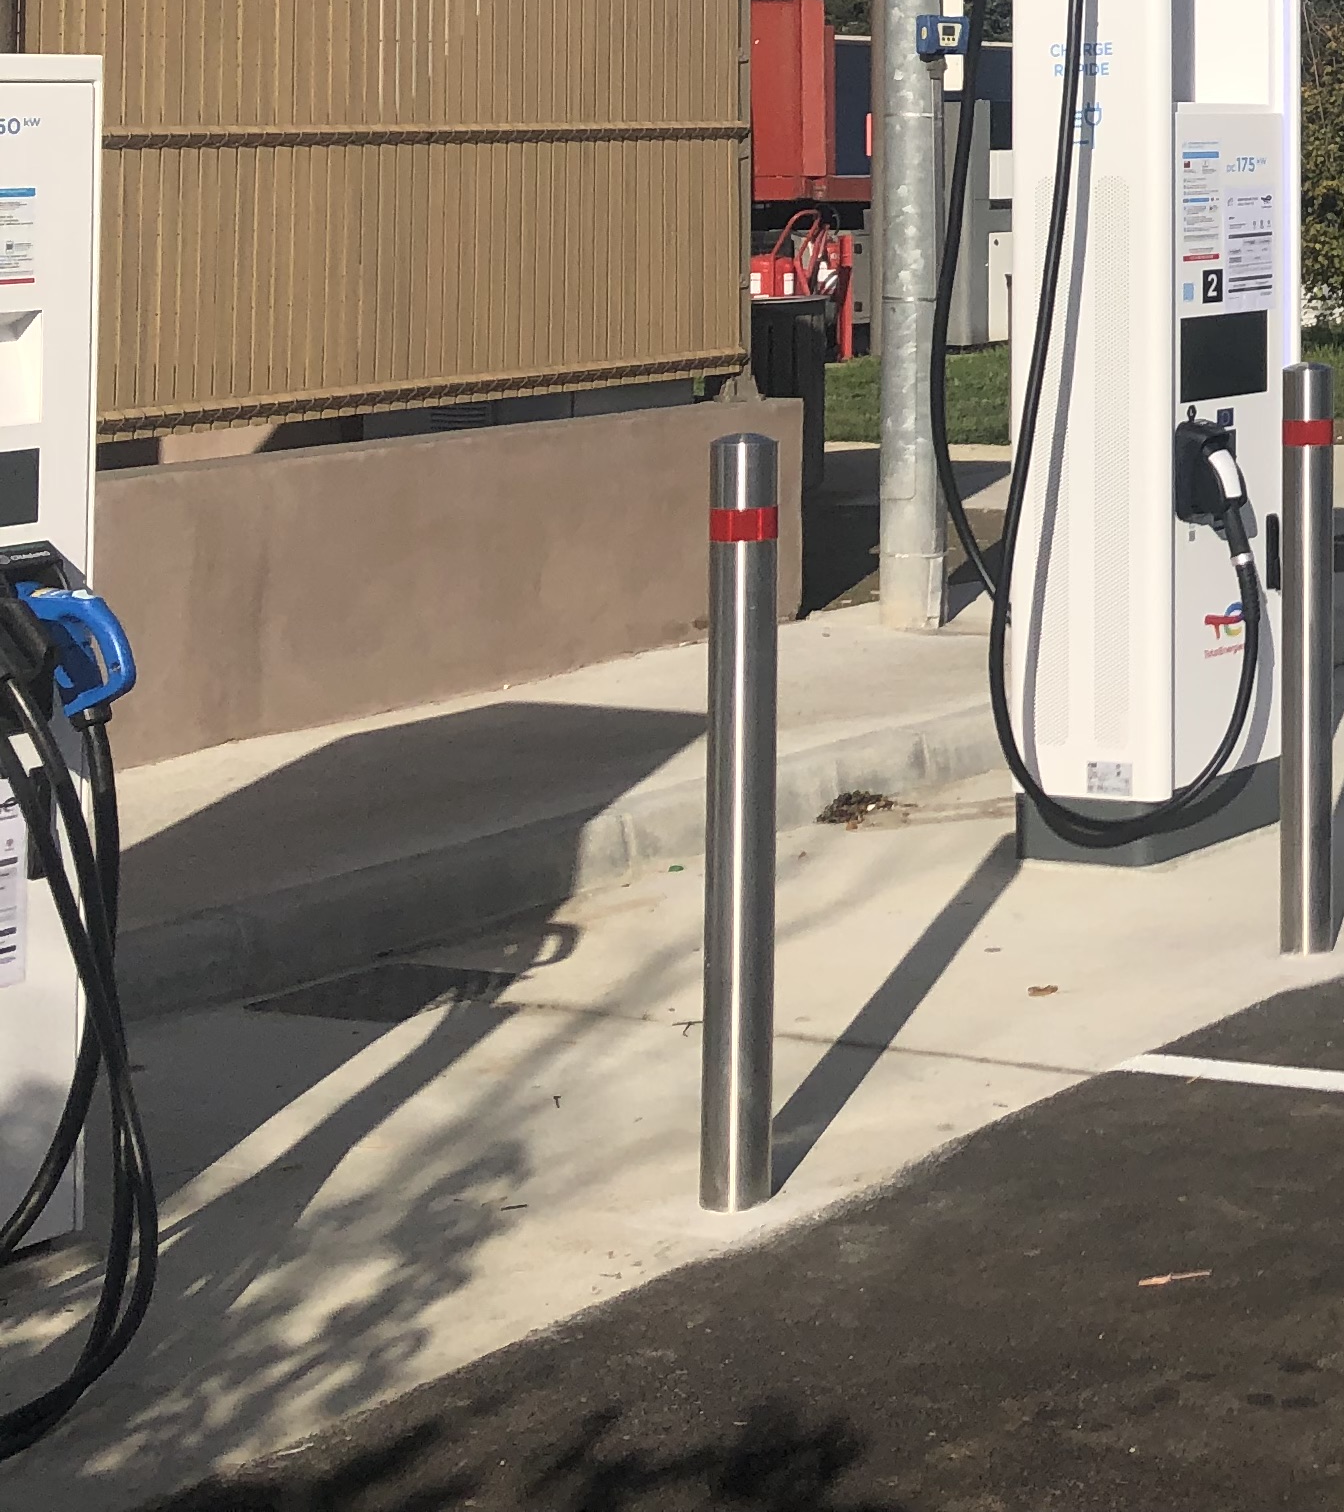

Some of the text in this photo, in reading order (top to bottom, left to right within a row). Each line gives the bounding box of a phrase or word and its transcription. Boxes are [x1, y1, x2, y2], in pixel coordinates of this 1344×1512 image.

[1050, 41, 1113, 58] CHRGE
[1054, 61, 1110, 77] RPIDE
[1236, 156, 1255, 173] 175
[1207, 273, 1218, 297] 2
